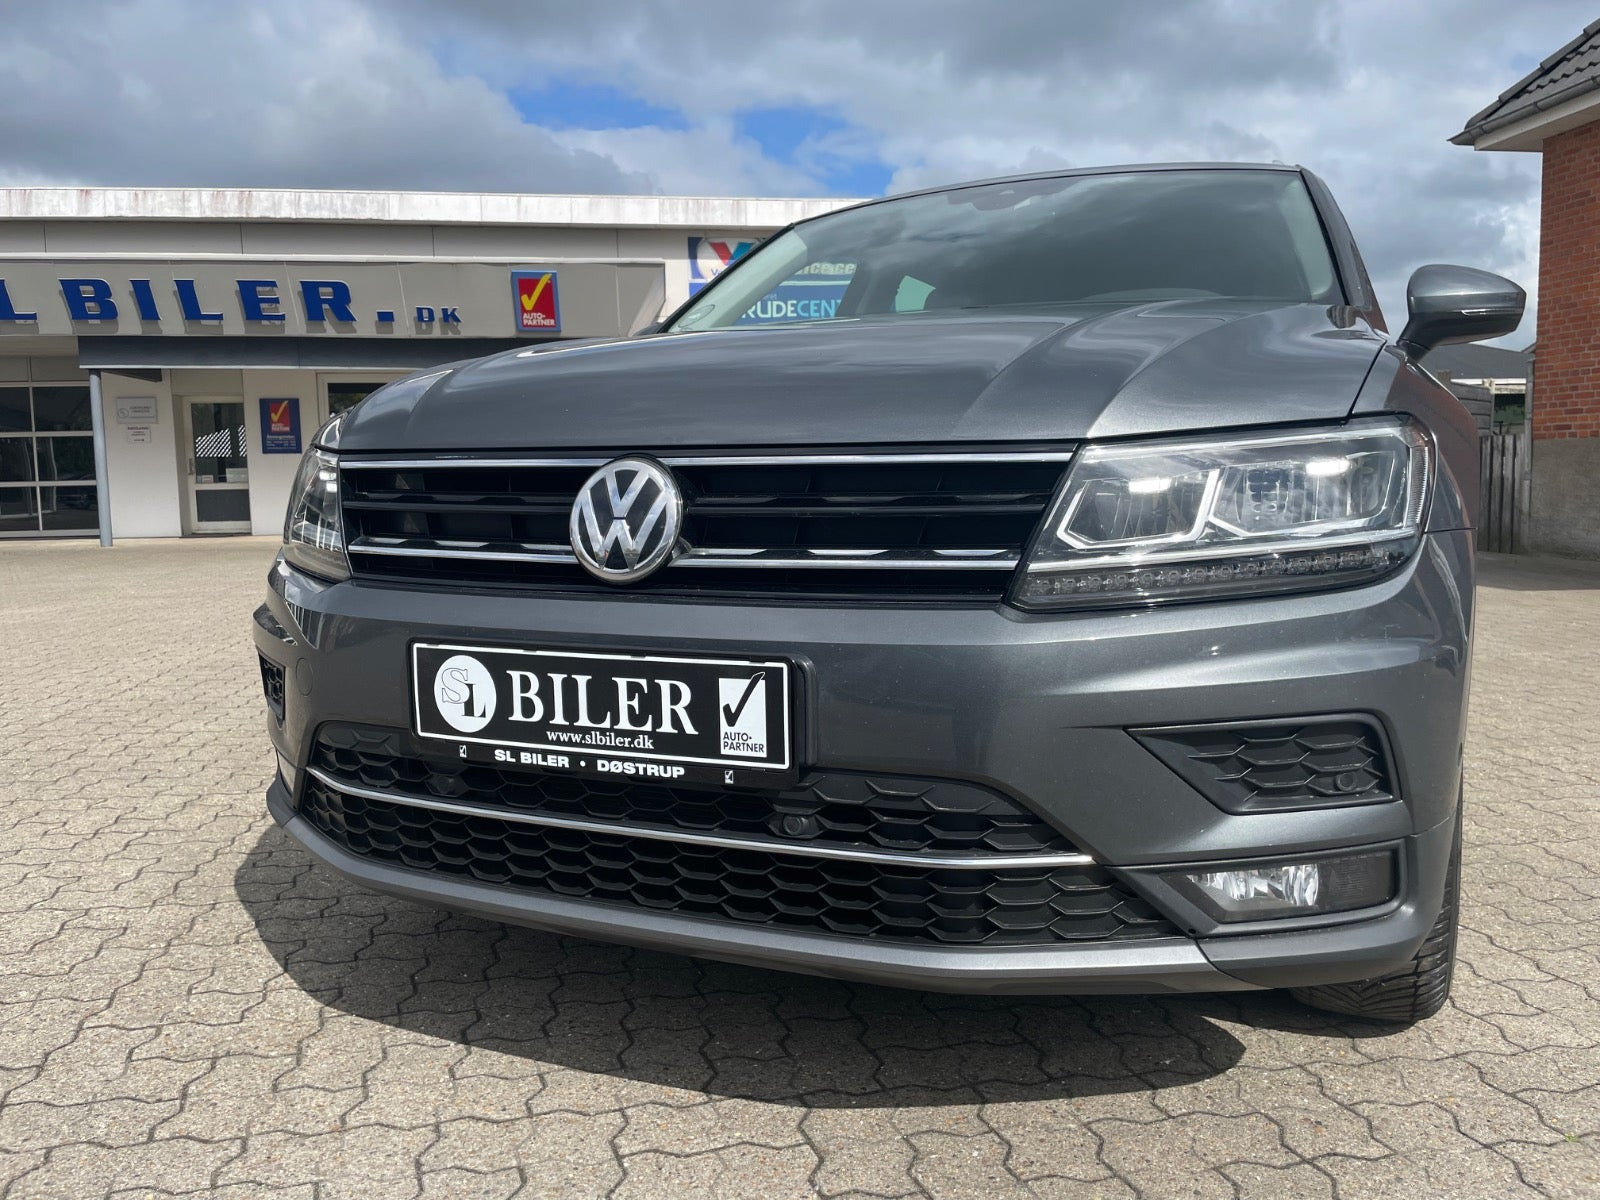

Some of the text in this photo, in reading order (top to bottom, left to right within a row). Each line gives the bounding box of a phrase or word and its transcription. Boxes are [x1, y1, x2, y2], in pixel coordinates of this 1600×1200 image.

[523, 318, 556, 326] PARTNER
[506, 669, 699, 735] BILER
[546, 730, 655, 750] www.slbiler.dk
[723, 740, 765, 753] PARTNER
[494, 749, 686, 779] SL BILER DØSTRUP
